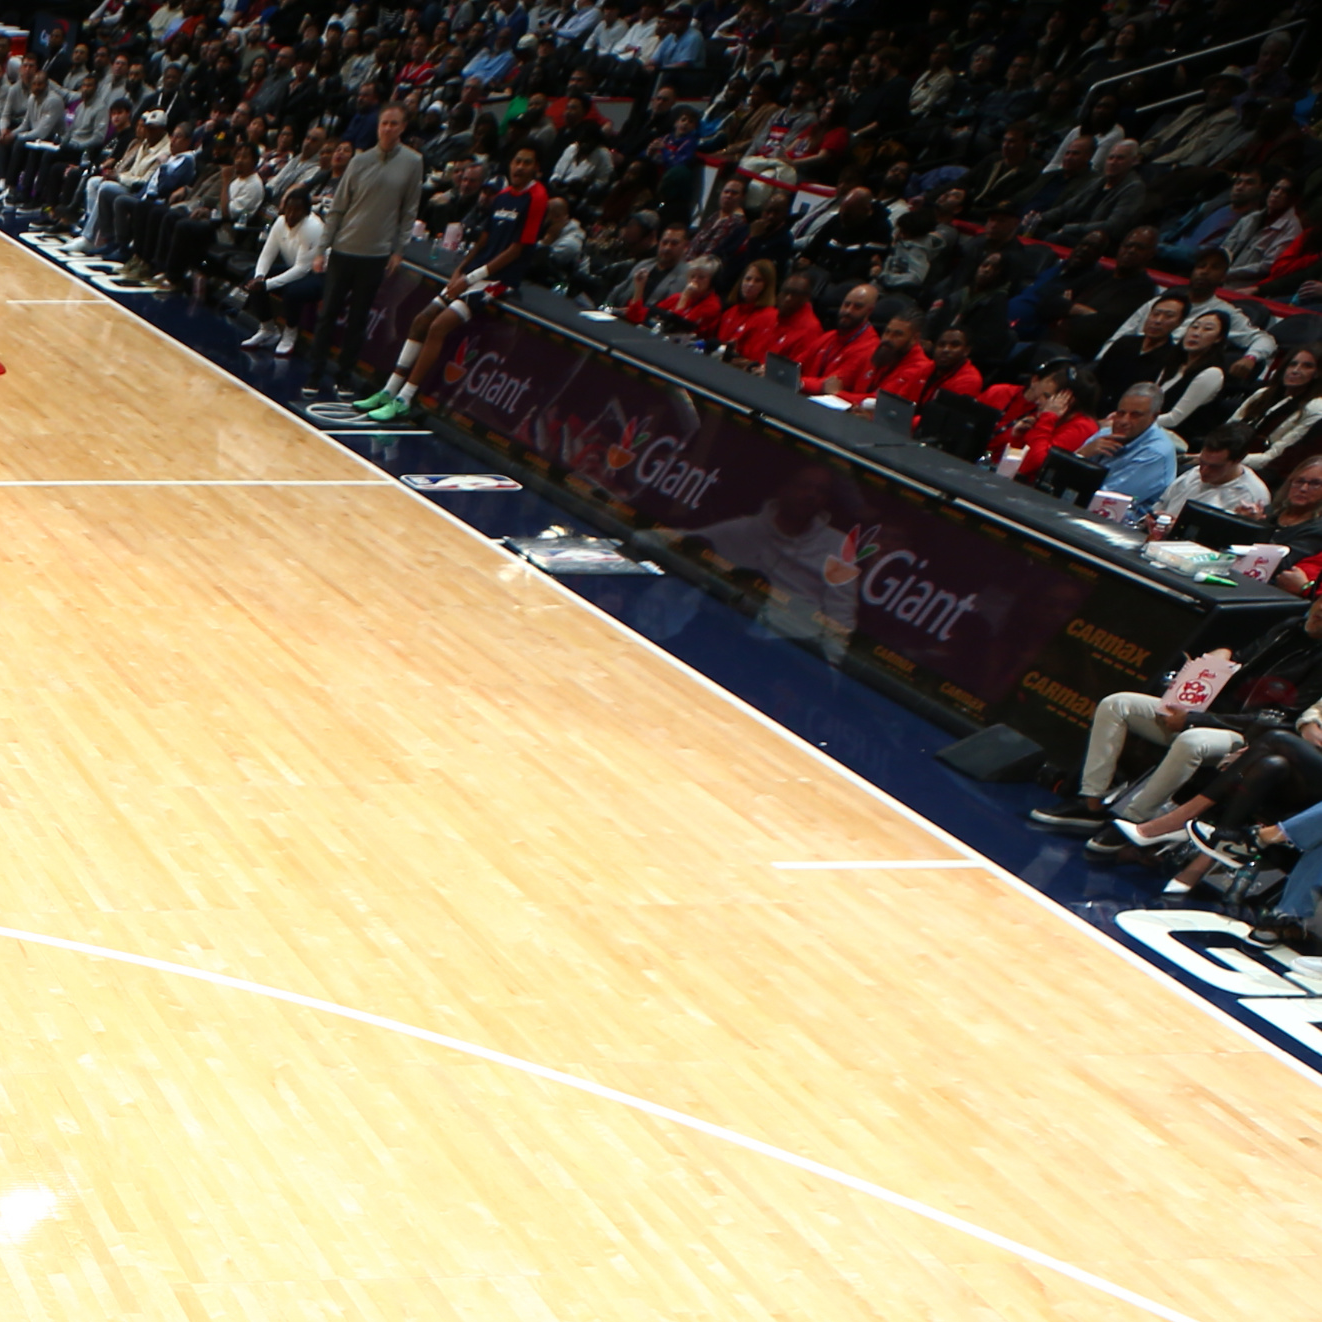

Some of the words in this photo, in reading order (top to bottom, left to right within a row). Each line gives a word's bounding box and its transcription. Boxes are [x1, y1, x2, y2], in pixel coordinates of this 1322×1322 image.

[463, 350, 533, 415] Giant
[634, 435, 722, 510] Giant
[861, 549, 979, 642] Giant
